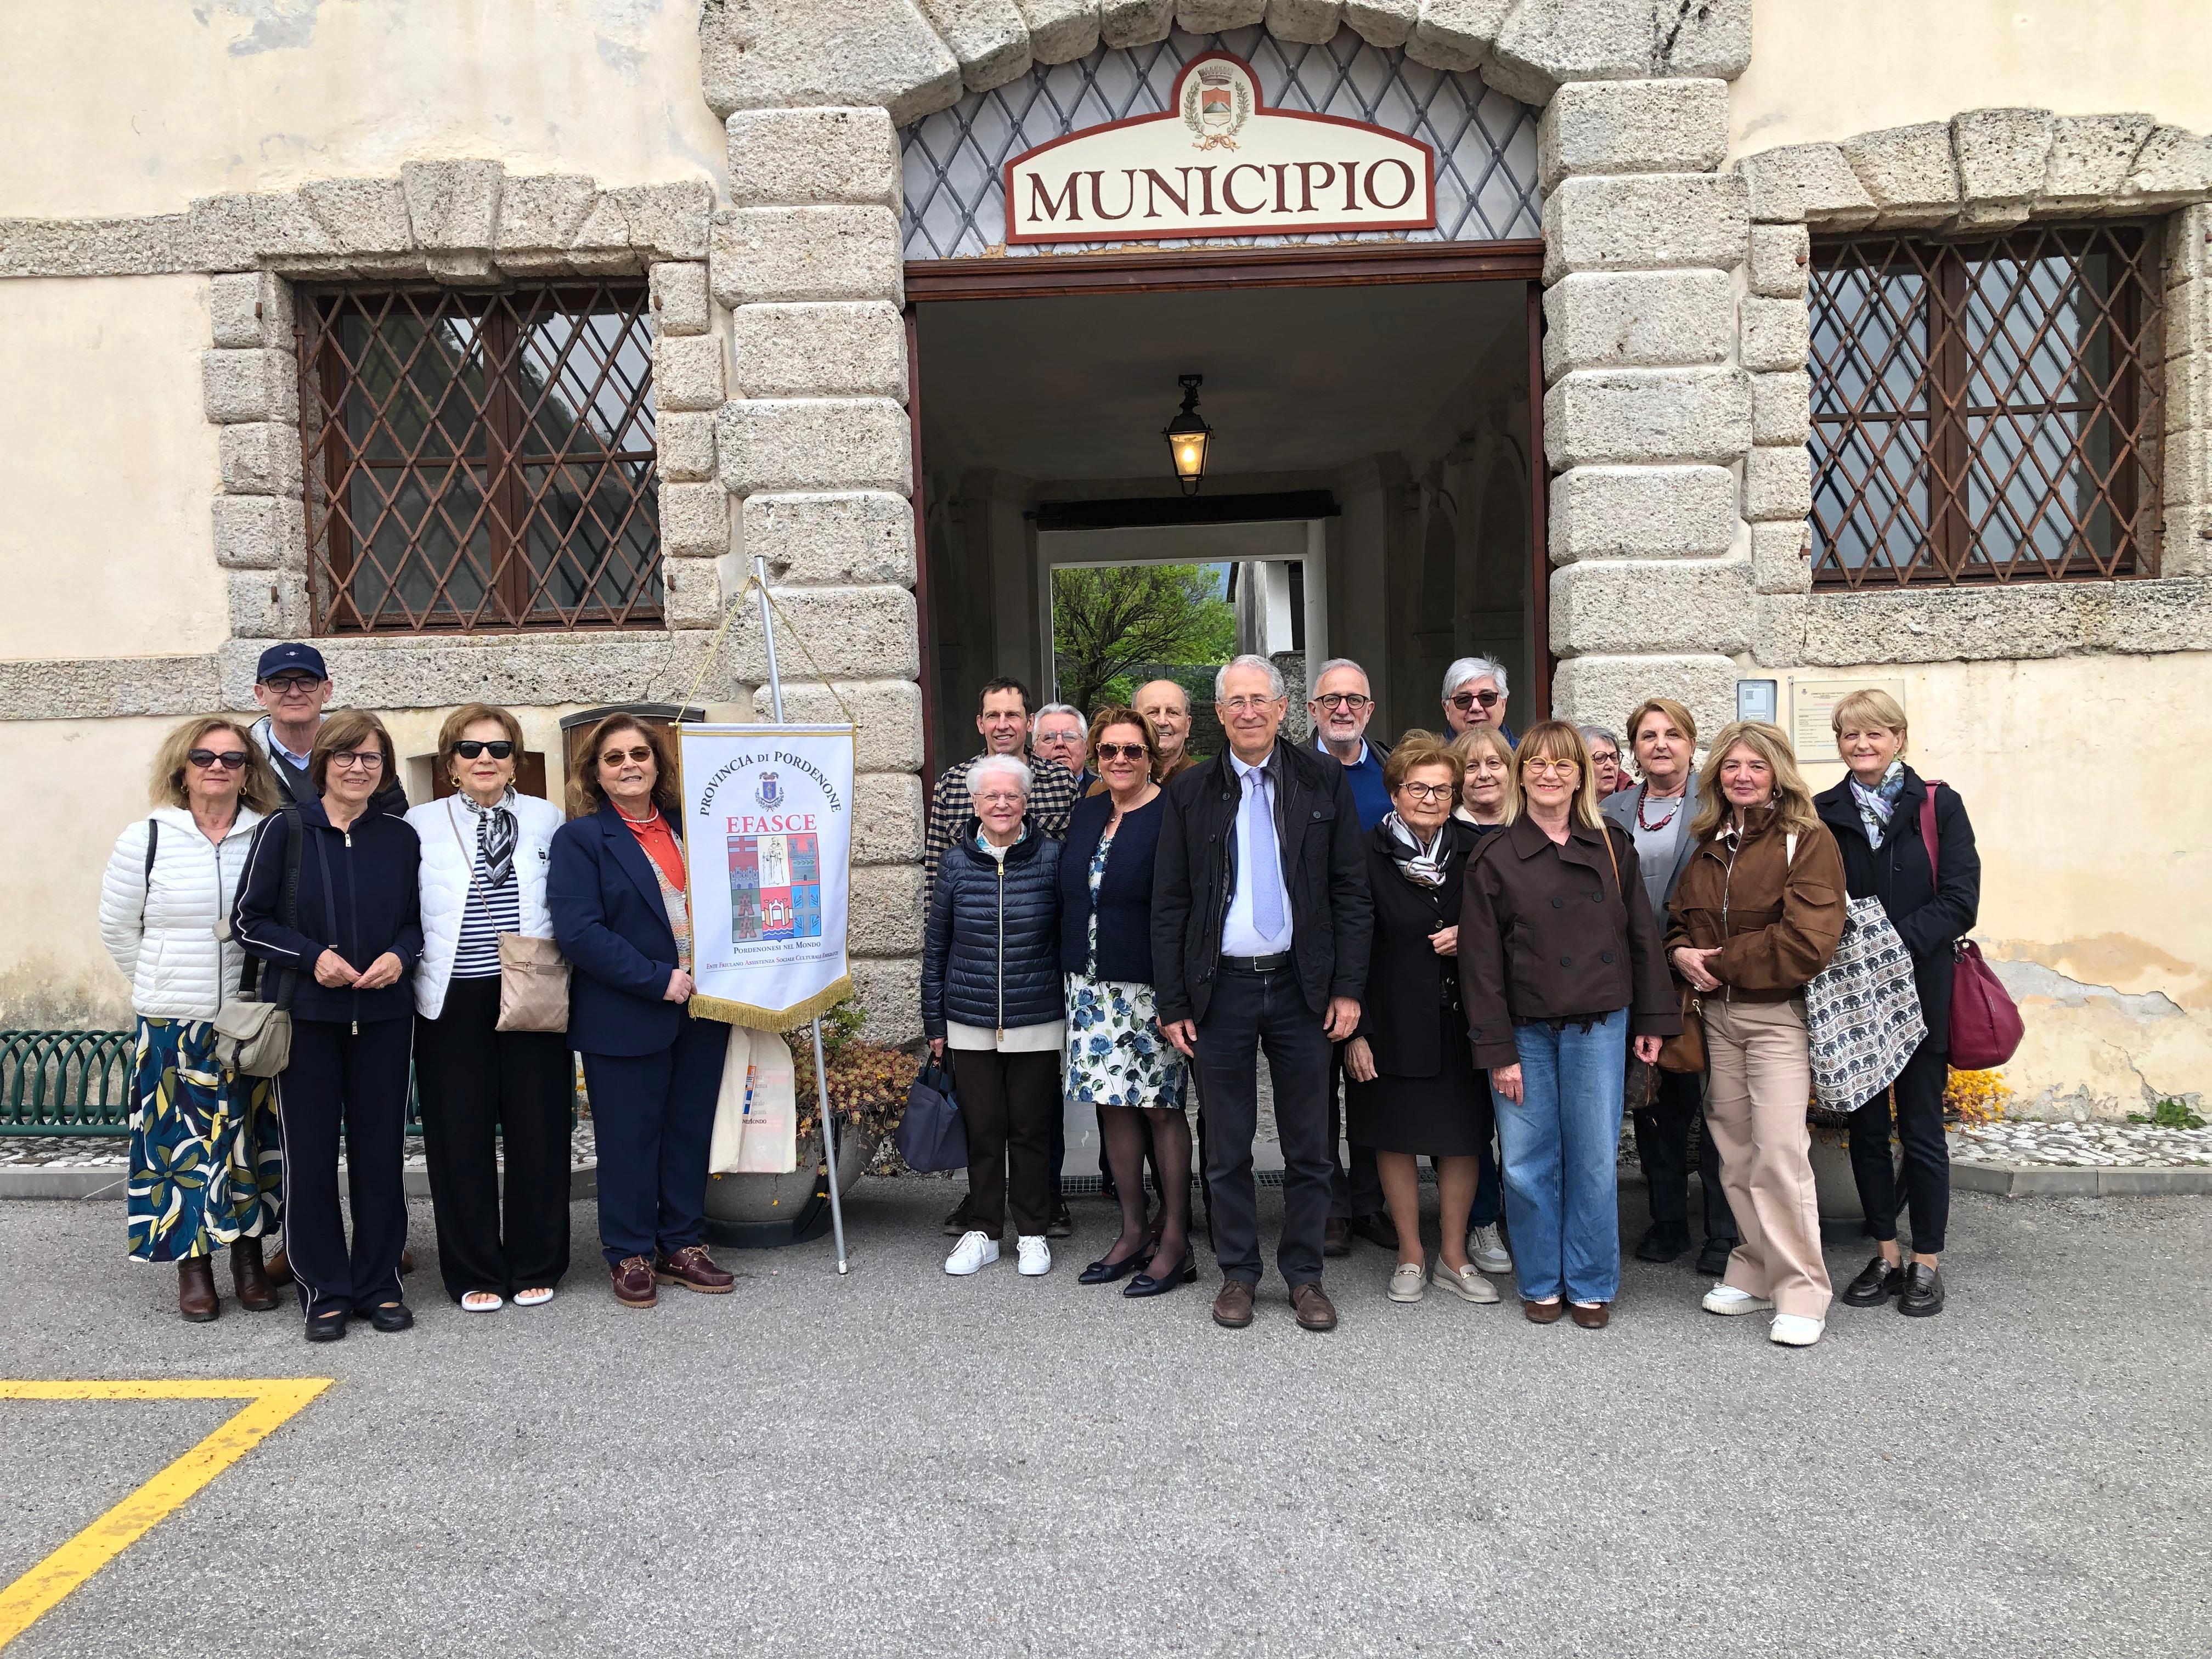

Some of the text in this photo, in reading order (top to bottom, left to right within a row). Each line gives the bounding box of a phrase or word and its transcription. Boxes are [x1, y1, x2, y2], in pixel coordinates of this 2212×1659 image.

[1026, 159, 1415, 222] MUNICIPIO
[700, 754, 754, 816] PROVINCIA
[774, 751, 841, 812] PORDENONE
[726, 814, 817, 833] EFASCE
[288, 868, 297, 898] YOUNG
[733, 945, 781, 954] PORDENONESI
